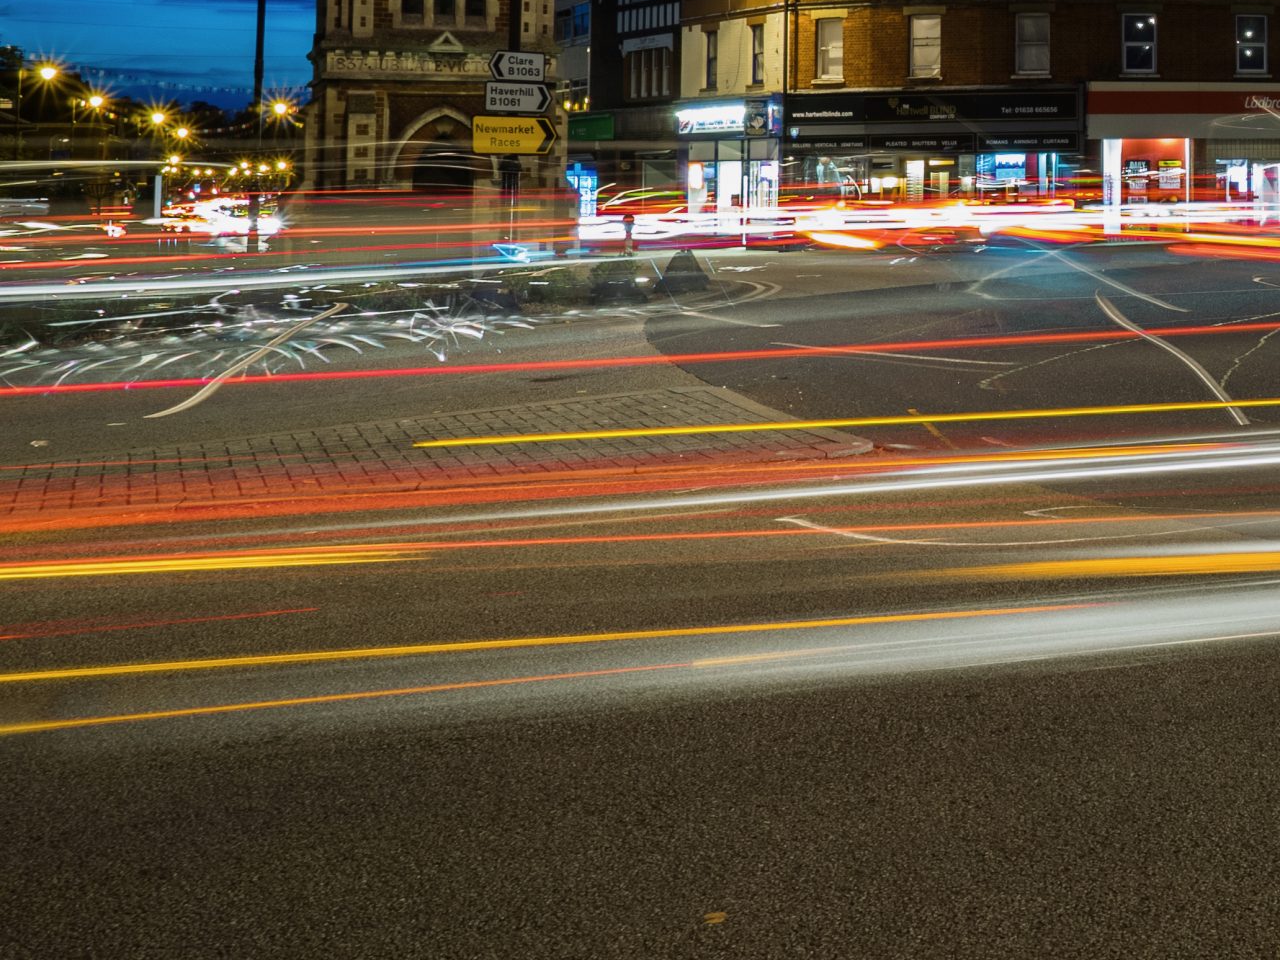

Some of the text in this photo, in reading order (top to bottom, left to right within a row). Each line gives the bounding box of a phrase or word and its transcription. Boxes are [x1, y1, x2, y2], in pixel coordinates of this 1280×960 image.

[508, 56, 535, 66] Clare
[508, 67, 541, 77] B1063
[490, 86, 535, 97] Haverhill
[490, 98, 520, 107] B1061
[896, 105, 957, 115] Hartwell BLIND
[475, 124, 535, 135] Newmarket
[490, 138, 520, 147] Races
